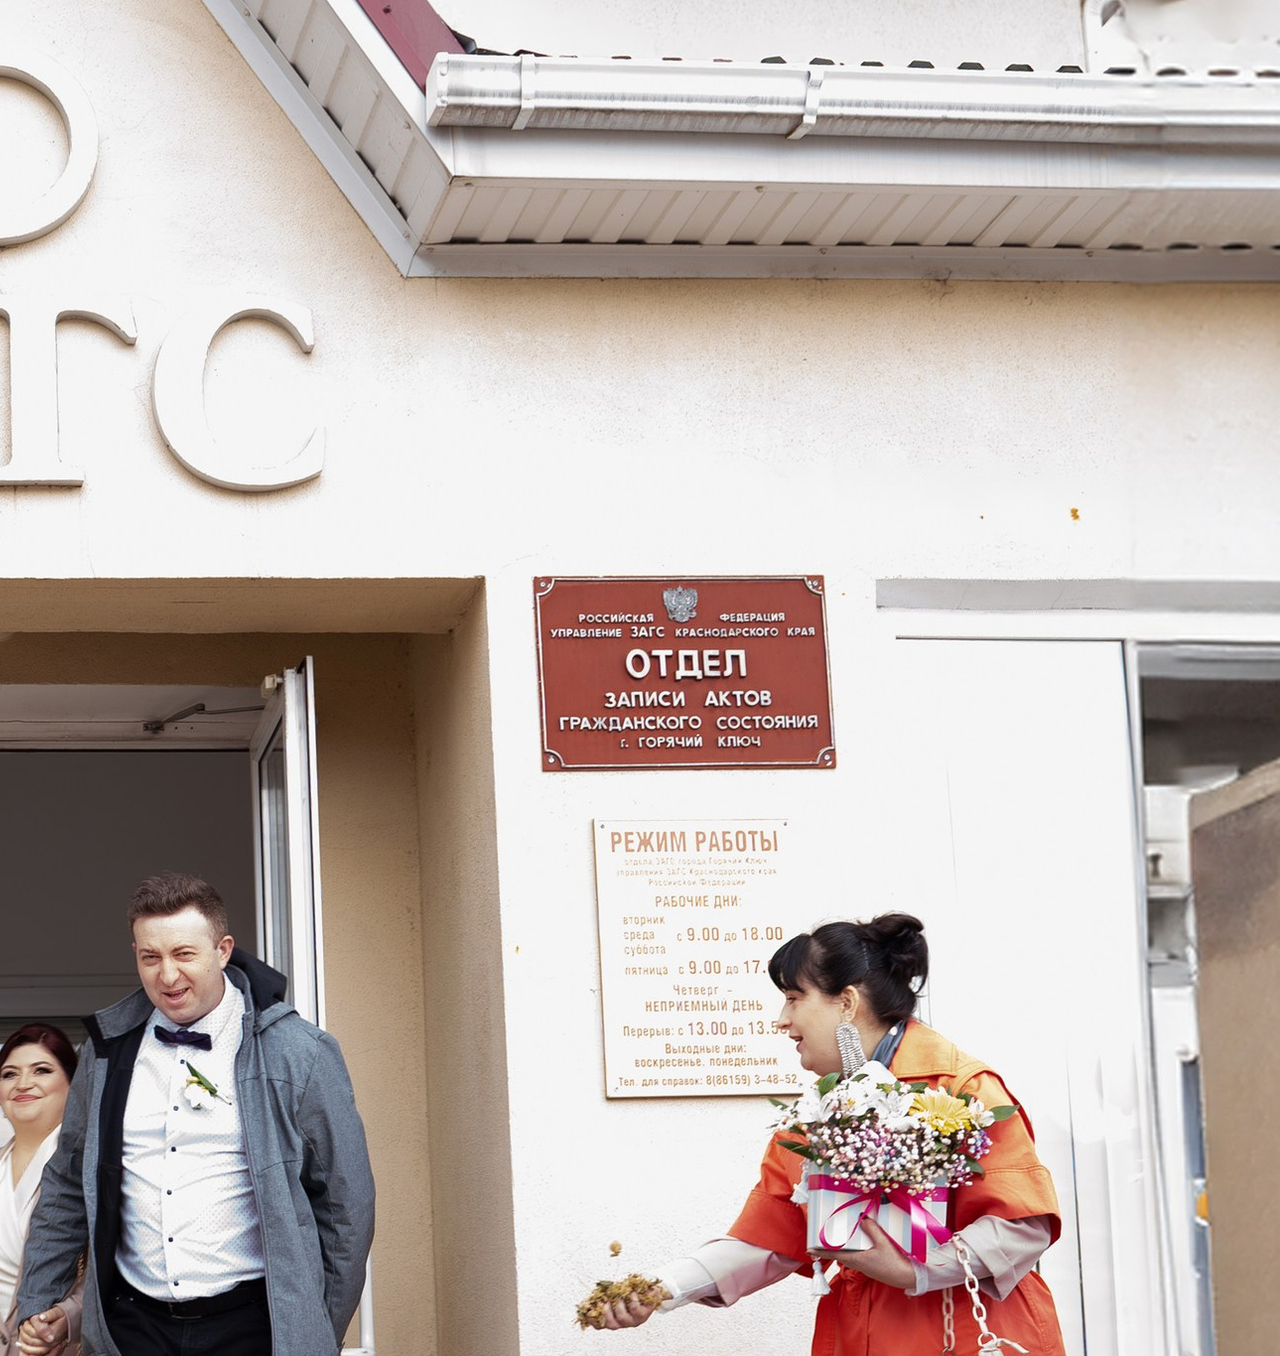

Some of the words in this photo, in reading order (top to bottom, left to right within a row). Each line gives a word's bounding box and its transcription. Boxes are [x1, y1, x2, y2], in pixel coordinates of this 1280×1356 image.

[578, 612, 654, 623] РОССИЙСКАЯ
[719, 612, 786, 623] ФЕДЕРАЦИЯ
[550, 628, 622, 638] УПРАВЛЕНИЕ
[631, 626, 665, 638] ЗАГС
[675, 627, 779, 638] КРАСНОДАРСКОГО
[787, 626, 816, 637] КРАЯ
[625, 648, 747, 680] ОТДЕЛ
[604, 691, 686, 708] ЗАПИСИ
[704, 690, 772, 707] АКТОВ
[559, 715, 702, 732] ГРАЖДАНСКОГО
[716, 715, 819, 730] СОСТОЯНИЯ
[638, 734, 703, 749] ГОРЯЧИЙ
[718, 736, 762, 747] КЛЮЧ
[610, 831, 687, 853] РЕЖИМ
[695, 830, 779, 852] РАБОТЫ
[655, 895, 709, 908] РАБОЧИЕ
[713, 895, 742, 909] ДНИ:
[623, 916, 666, 927] вторник
[623, 931, 655, 941] среда
[687, 927, 720, 942] 9.00
[724, 932, 737, 942] до
[742, 927, 783, 941] 18.00
[624, 944, 666, 957] суббота
[625, 966, 668, 976] пятница
[688, 960, 721, 975] 9.00
[725, 965, 738, 976] до
[673, 984, 719, 997] Четверг
[645, 998, 728, 1012] НЕПРИЕМНЫЙ
[732, 1000, 763, 1013] ДЕНЬ
[623, 1025, 674, 1038] Перерыв:
[688, 1021, 728, 1036] 13.00
[732, 1027, 744, 1036] до
[665, 1043, 720, 1055] Выходные
[724, 1044, 747, 1055] дни:
[709, 1056, 778, 1068] понедельник
[641, 1077, 659, 1088] для
[662, 1076, 703, 1088] справок:
[705, 1074, 751, 1087] 8(86159)
